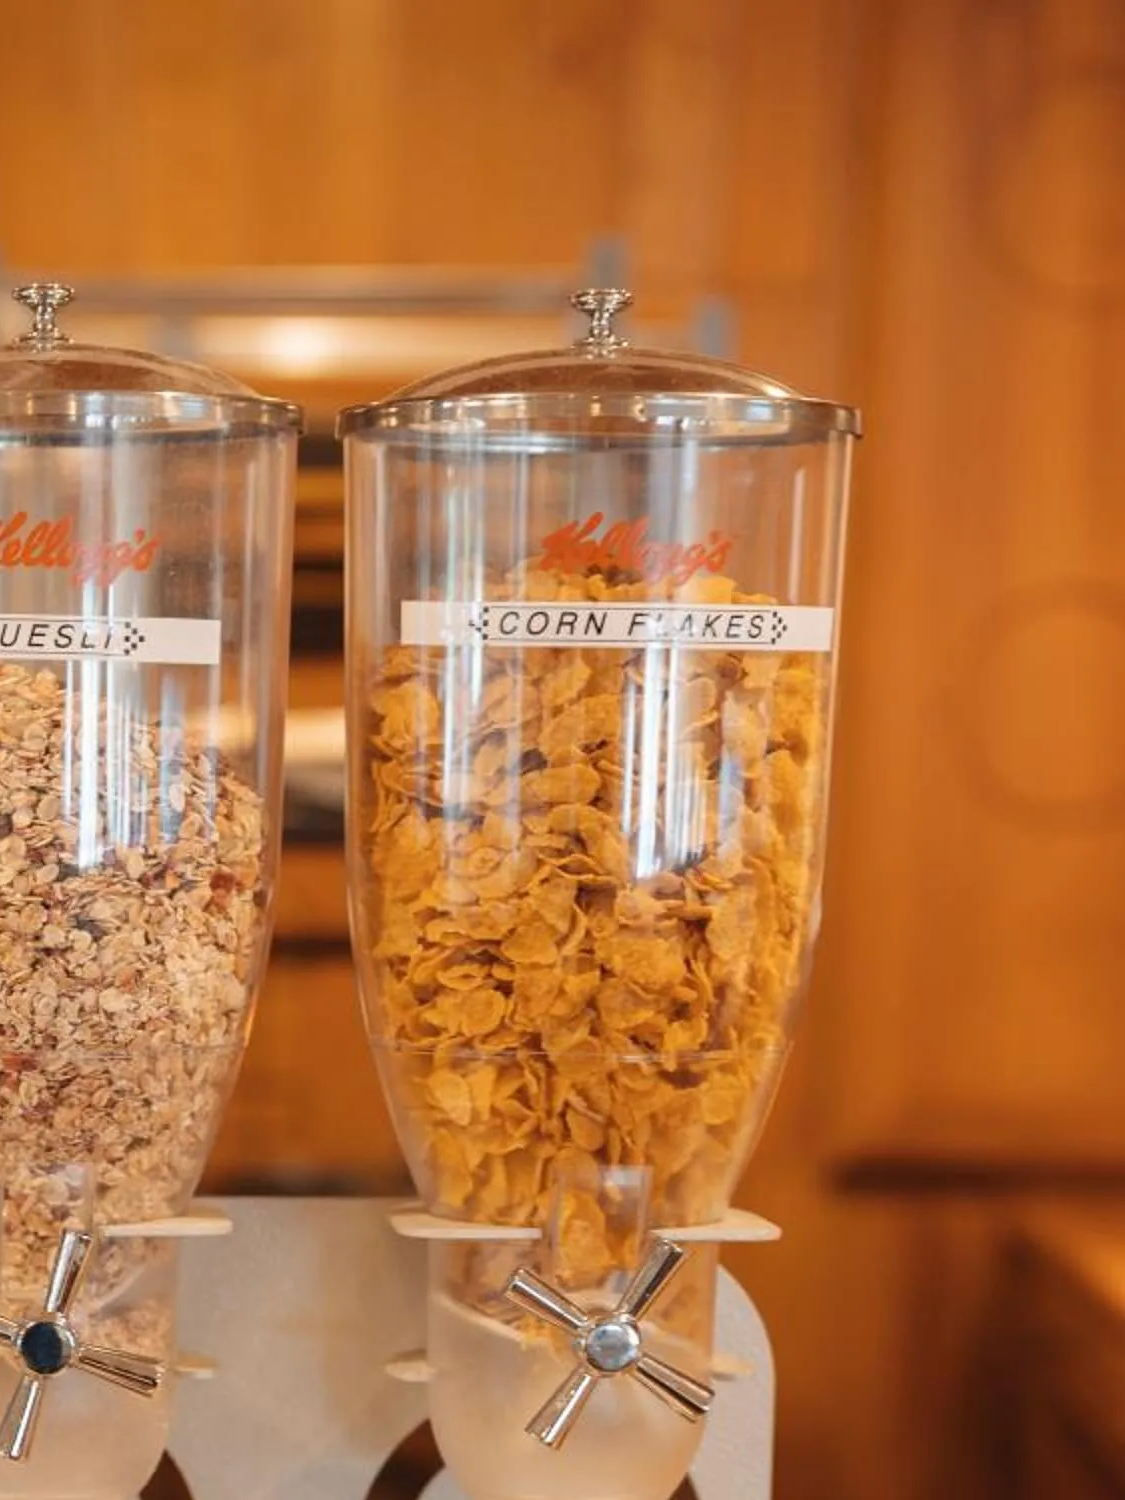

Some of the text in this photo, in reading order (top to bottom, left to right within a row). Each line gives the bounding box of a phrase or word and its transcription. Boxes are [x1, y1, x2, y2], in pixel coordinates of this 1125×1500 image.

[539, 511, 732, 586] Kellogg's
[498, 610, 766, 640] CORN FLAKES
